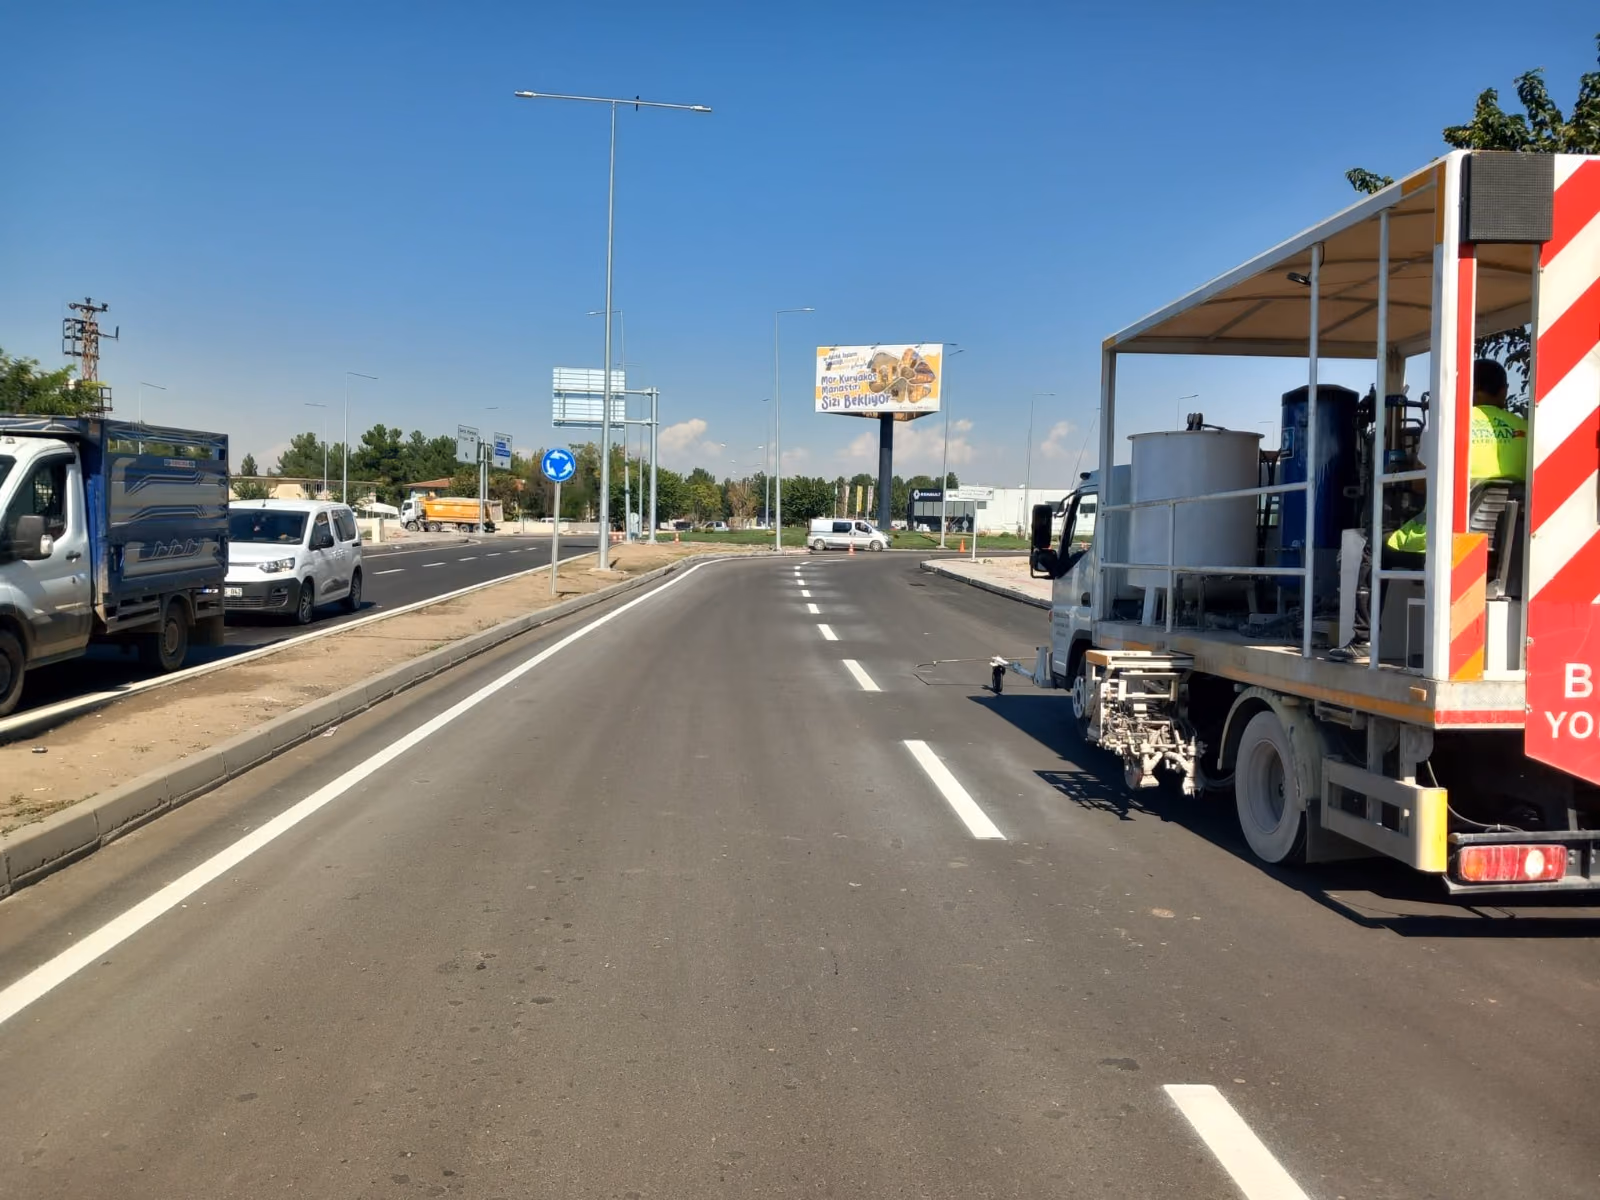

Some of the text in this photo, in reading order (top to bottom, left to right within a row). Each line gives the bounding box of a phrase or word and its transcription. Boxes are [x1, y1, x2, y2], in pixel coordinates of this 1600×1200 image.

[821, 373, 877, 385] Mor Kuryakos
[821, 393, 891, 410] Sizi Bekliyor
[1544, 710, 1600, 739] YO
